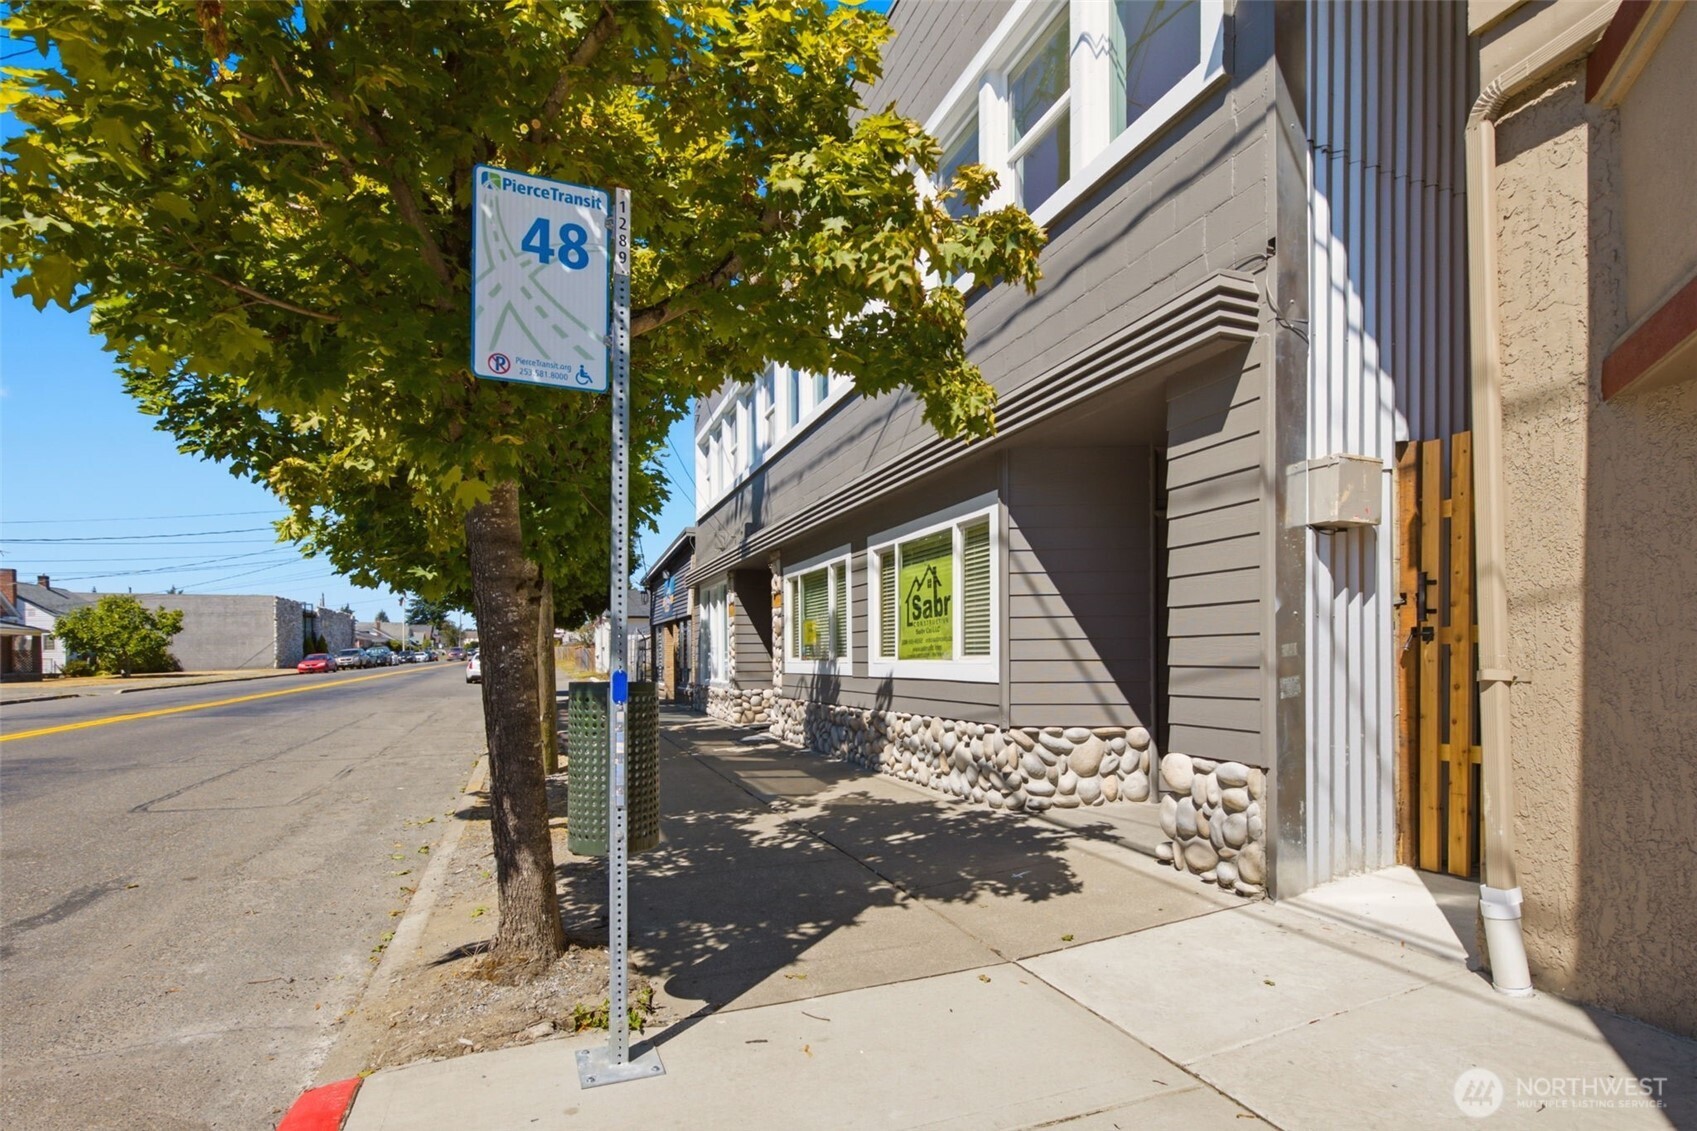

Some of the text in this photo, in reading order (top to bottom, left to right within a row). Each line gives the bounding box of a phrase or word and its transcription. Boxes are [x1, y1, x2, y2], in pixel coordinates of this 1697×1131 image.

[502, 177, 602, 210] PierceTransit
[521, 217, 590, 270] 48
[618, 201, 627, 264] 1289
[515, 356, 572, 373] PierceTransit.org
[912, 580, 951, 620] Sabr
